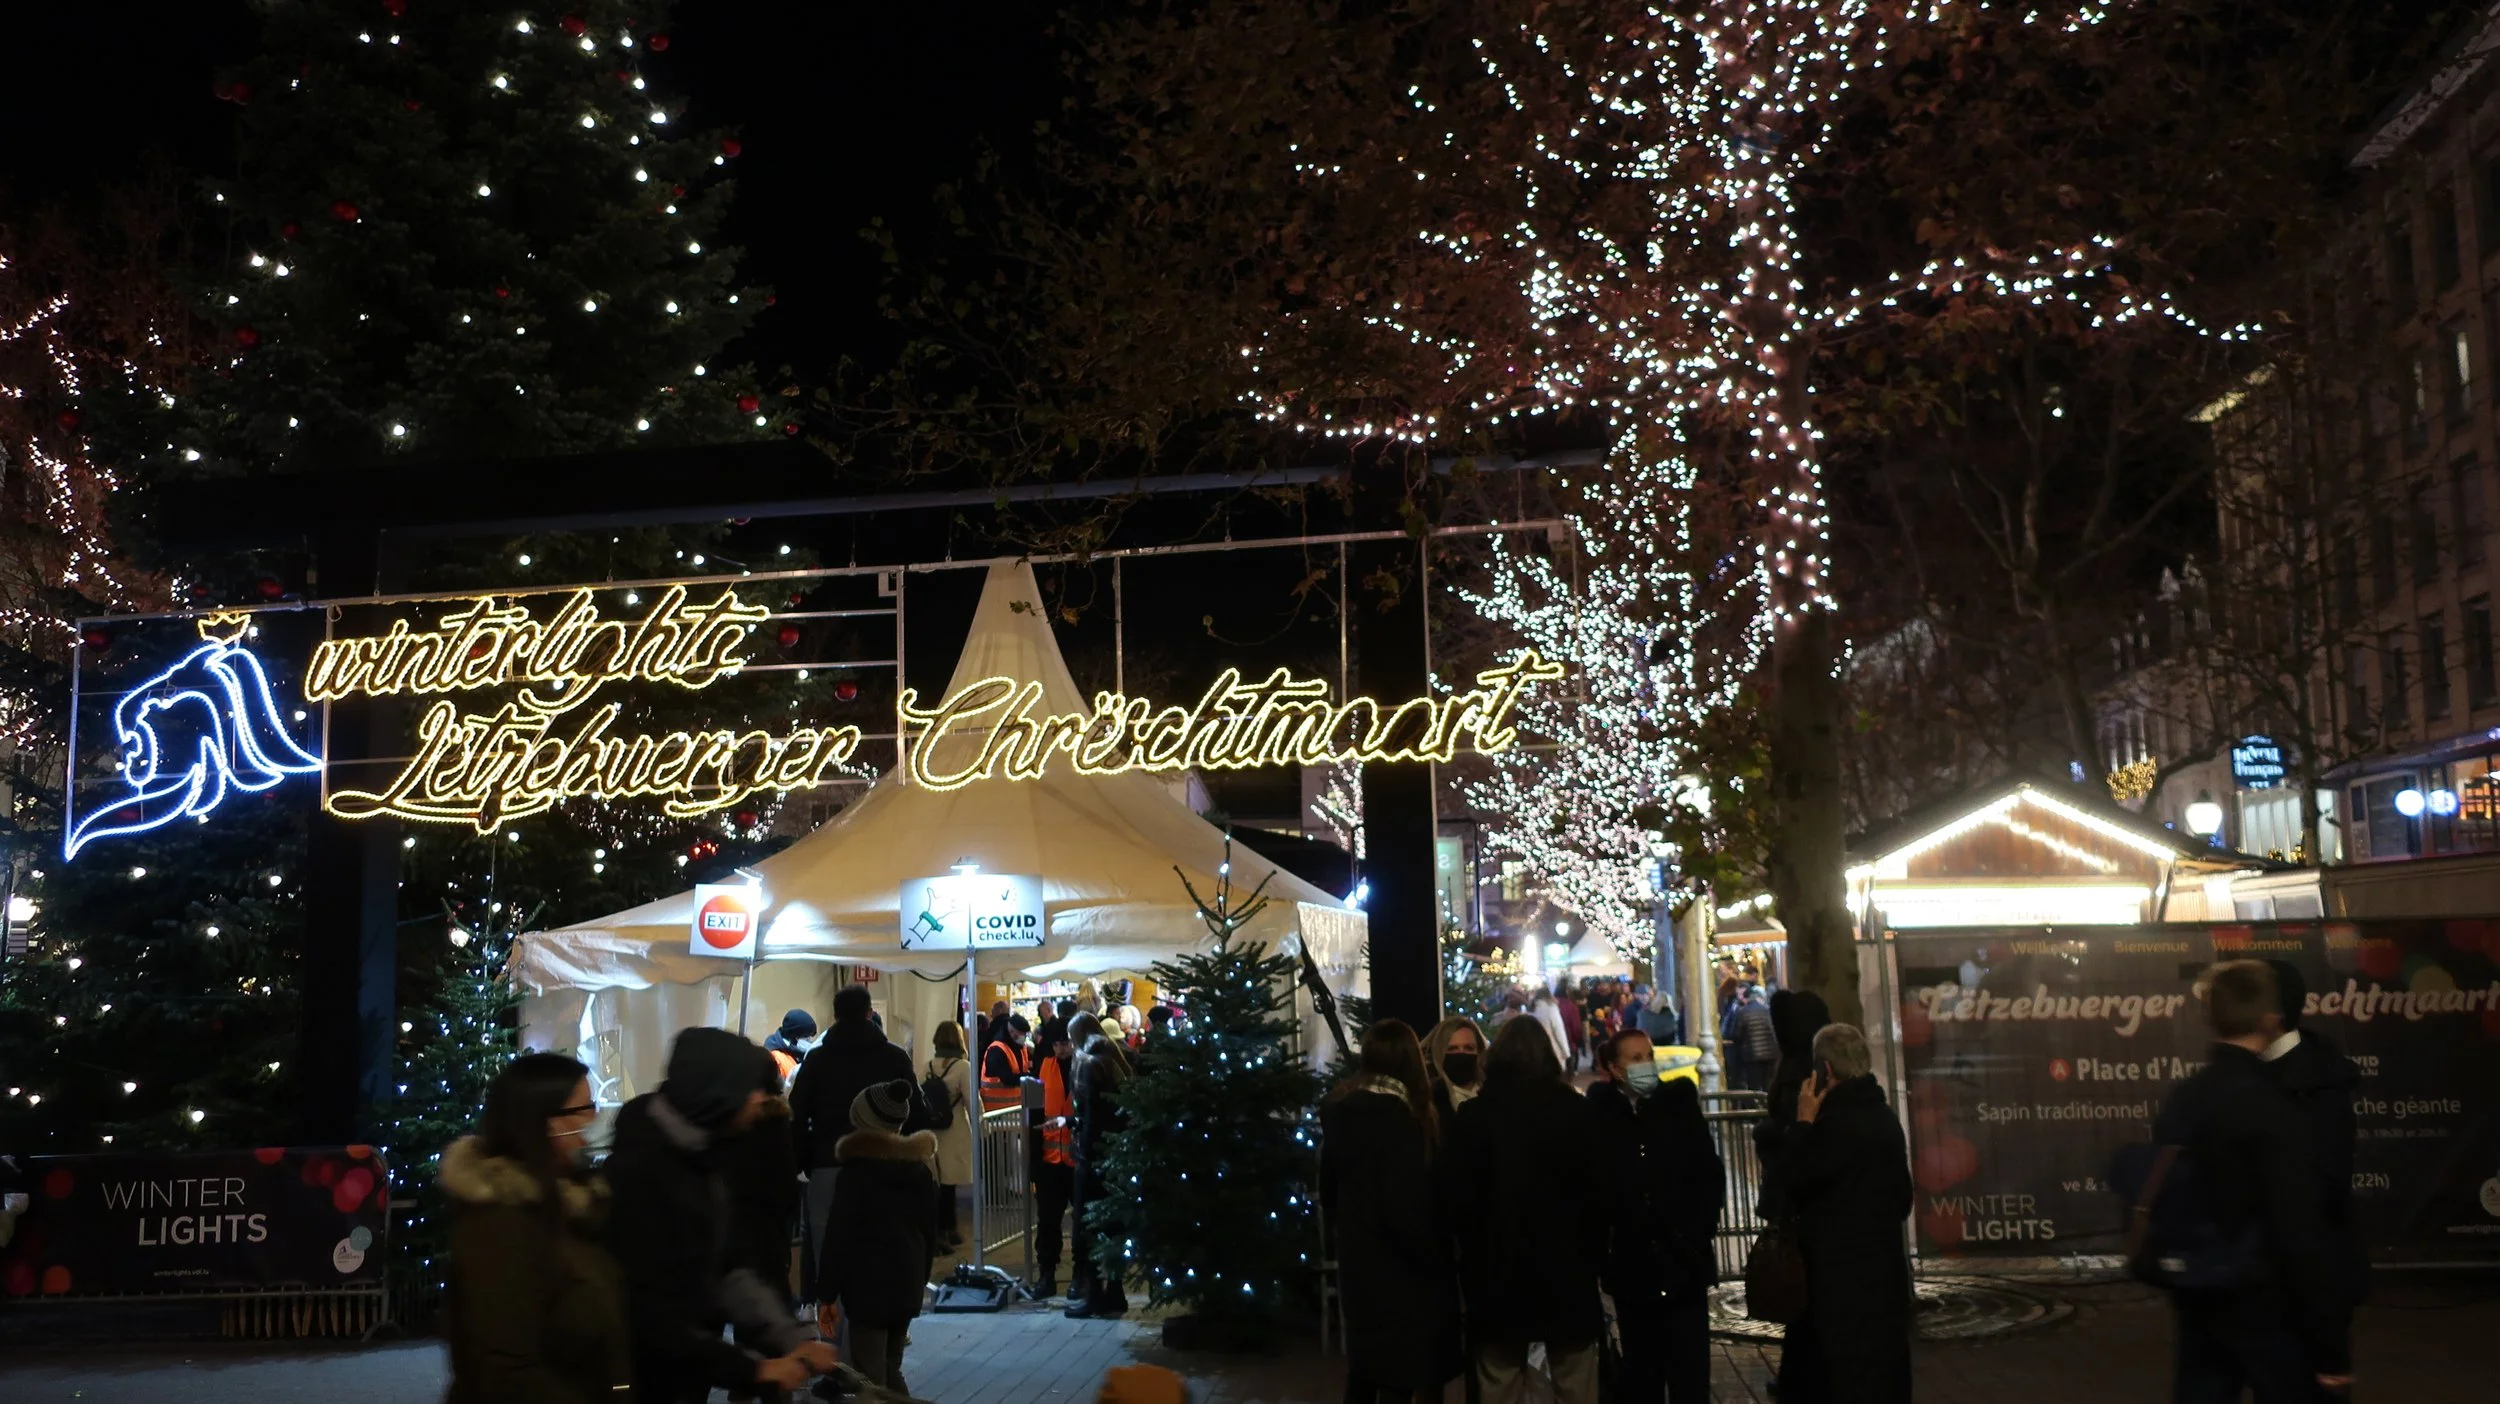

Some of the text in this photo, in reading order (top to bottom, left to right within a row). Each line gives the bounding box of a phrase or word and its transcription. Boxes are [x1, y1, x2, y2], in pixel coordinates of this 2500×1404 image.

[304, 587, 770, 714] winterlights
[328, 650, 1563, 835] Lëtzebuerger Chrëschtmaart
[706, 913, 741, 929] EXIT
[976, 915, 1037, 930] COVID
[979, 930, 1035, 942] check.lu
[2114, 941, 2189, 953] Bienvenue
[2212, 938, 2303, 952] Willkommen
[1919, 981, 2185, 1037] Lëtzebuerger
[2077, 1058, 2140, 1081] Place
[1978, 1103, 2030, 1124] Sapin
[2037, 1099, 2149, 1121] traditionnel
[2394, 1095, 2461, 1118] géante
[101, 1177, 247, 1210] WINTER
[1931, 1195, 2036, 1216] WINTER
[138, 1214, 269, 1246] LIGHTS
[1962, 1219, 2056, 1241] LIGHTS
